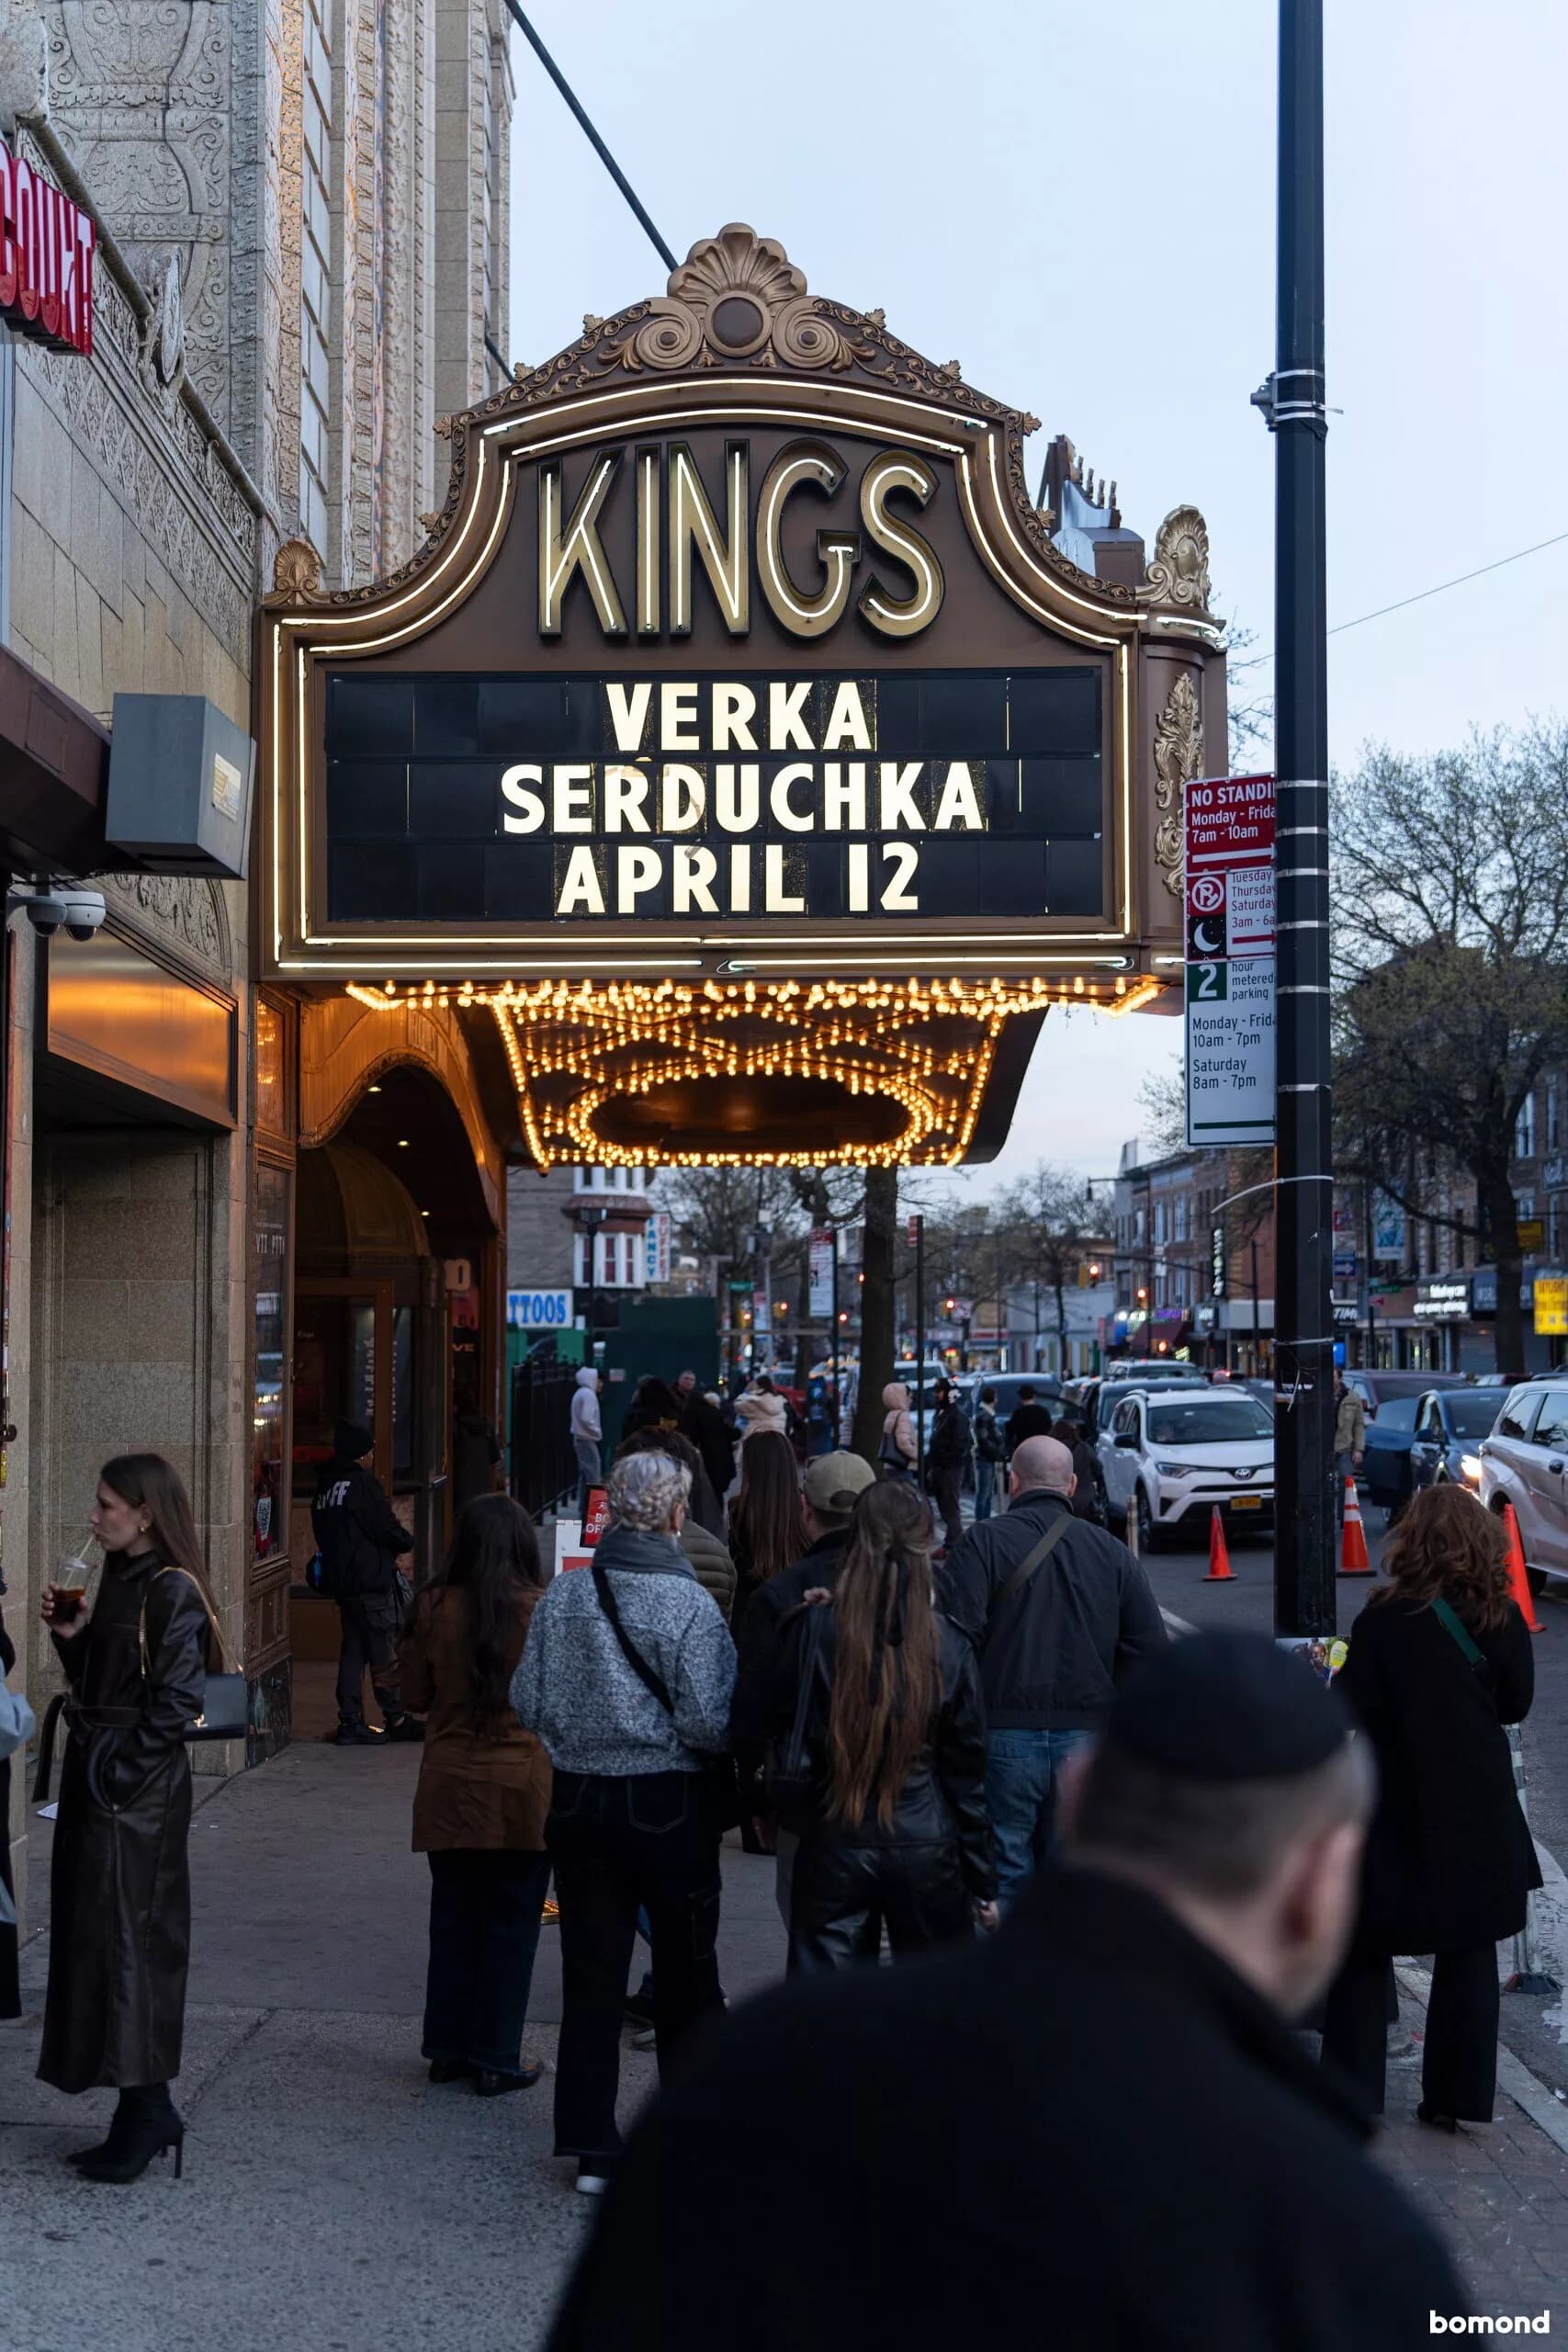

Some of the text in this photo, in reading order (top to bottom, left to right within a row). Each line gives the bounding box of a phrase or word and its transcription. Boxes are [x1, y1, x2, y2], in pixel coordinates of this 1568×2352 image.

[537, 437, 945, 638] KINGS
[606, 682, 872, 752] VERKA
[500, 763, 984, 834] SERDUCHKA
[1191, 782, 1275, 807] NO STANDI
[1191, 809, 1236, 826] Monday
[1191, 830, 1216, 843] 7am
[1228, 825, 1258, 840] 10am
[557, 842, 919, 913] APRIL 12
[1232, 870, 1272, 883] Tuesday
[1232, 917, 1253, 928] 3am
[1263, 914, 1275, 925] 6a
[1198, 962, 1255, 998] 2 hour
[1232, 973, 1274, 986] metered
[1232, 988, 1269, 1002] parking
[1192, 1016, 1238, 1031] Monday
[1193, 1035, 1224, 1047] 10am
[1235, 1032, 1260, 1047] 7pm
[1193, 1057, 1247, 1073] Saturday
[1193, 1076, 1219, 1090] 8am
[1231, 1074, 1257, 1090] 7pm
